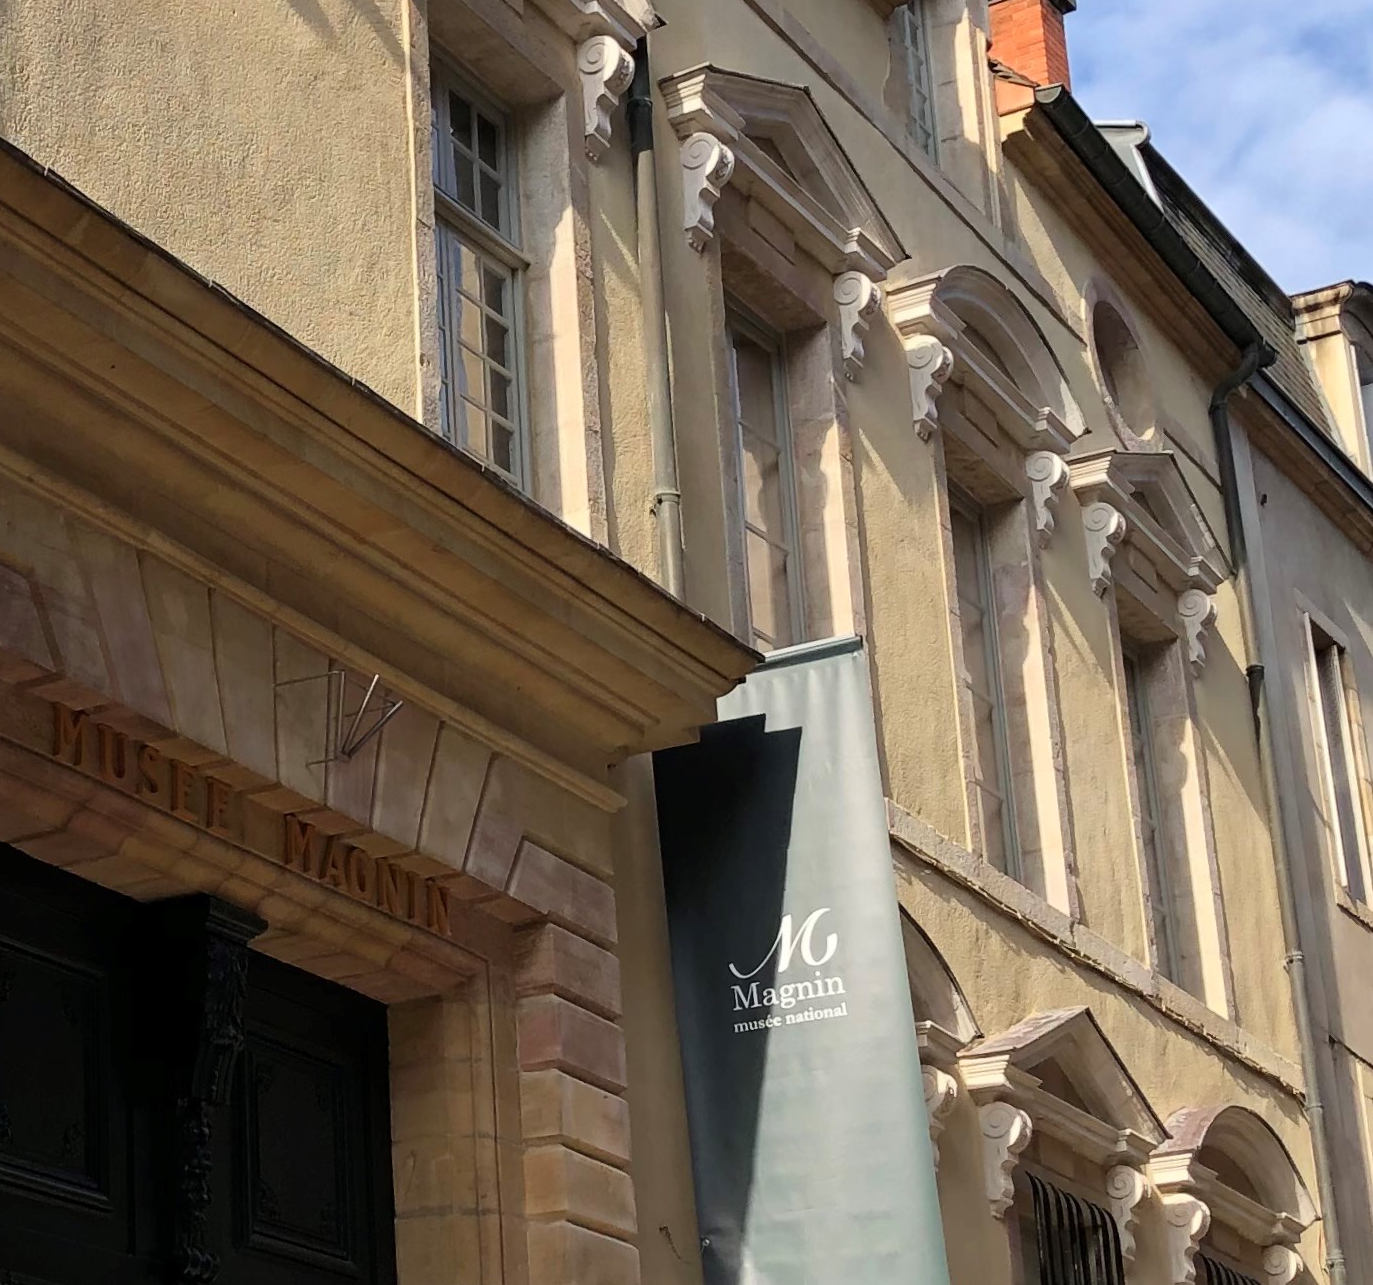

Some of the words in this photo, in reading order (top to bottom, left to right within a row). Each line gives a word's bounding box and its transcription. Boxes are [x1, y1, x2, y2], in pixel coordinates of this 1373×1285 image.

[284, 812, 453, 937] MAGNIN
[730, 971, 846, 1011] Magnin
[733, 1015, 782, 1033] musée
[785, 1001, 848, 1025] national
